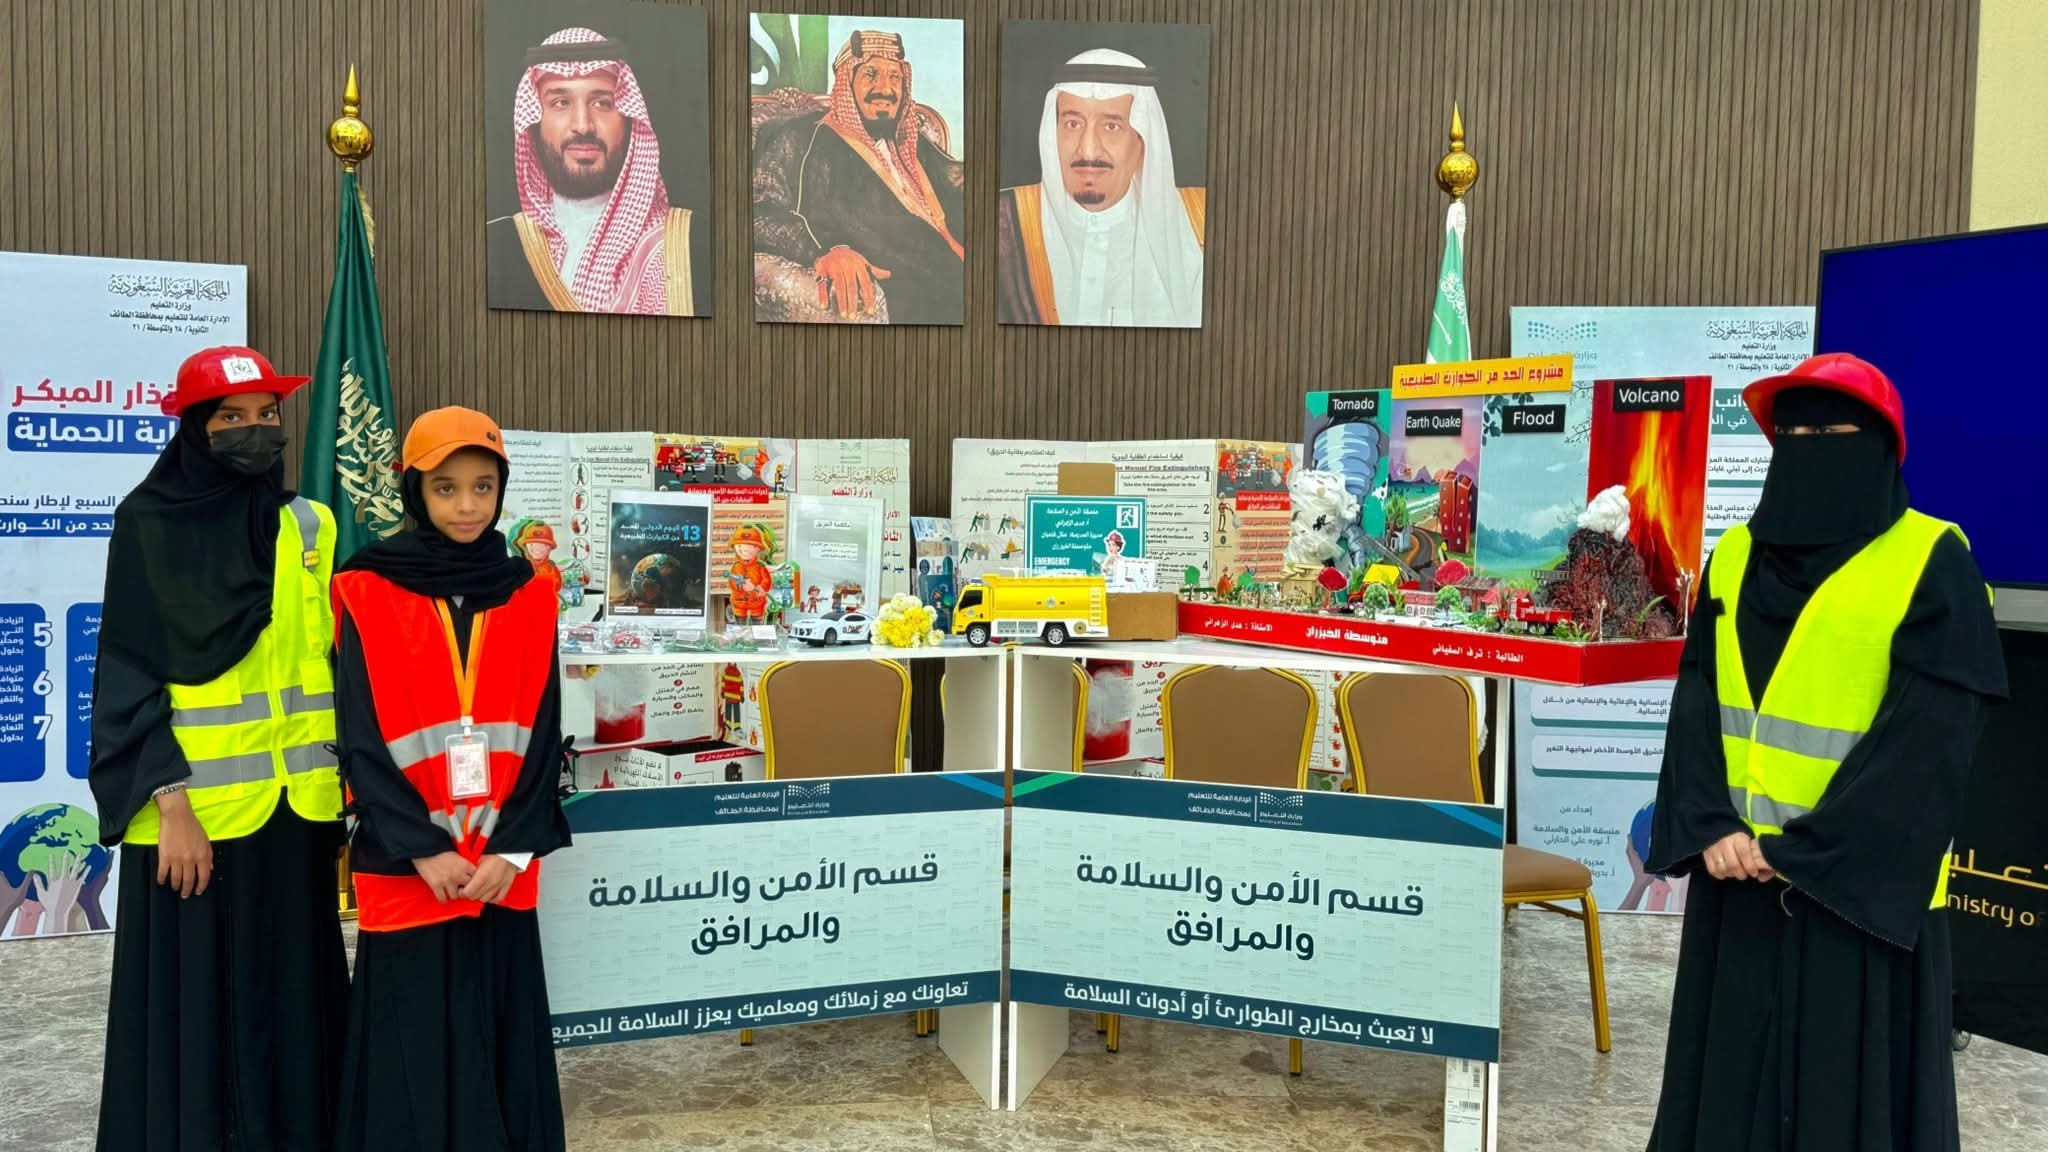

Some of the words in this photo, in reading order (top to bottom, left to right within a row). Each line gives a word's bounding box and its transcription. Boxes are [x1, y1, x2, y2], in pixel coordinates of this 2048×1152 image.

[1399, 372, 1439, 390] الطبيعية
[1443, 367, 1482, 387] الكوارث
[1503, 366, 1524, 382] الحد
[1528, 363, 1563, 383] مشروع
[12, 378, 112, 408] المبكر
[1332, 397, 1375, 411] Tornado
[1618, 387, 1680, 404] Volcano
[1406, 416, 1430, 429] Earth
[1432, 415, 1462, 430] Quake
[1512, 411, 1555, 426] Flood
[1727, 414, 1747, 430] في
[14, 416, 124, 448] الحماية
[75, 495, 116, 509] السبع
[1203, 504, 1210, 514] 2
[65, 521, 87, 532] من
[681, 525, 701, 542] 13
[1203, 531, 1209, 542] 3
[1034, 557, 1070, 566] EMERGENCY
[1203, 560, 1208, 571] 4
[33, 622, 52, 648] 5
[1344, 629, 1388, 646] متوسطة
[33, 671, 53, 696] 6
[33, 715, 53, 741] 7
[1559, 806, 1571, 814] من
[1571, 825, 1591, 834] الأمن
[759, 857, 846, 899] الأمن
[853, 852, 938, 893] قسم
[1076, 855, 1223, 902] والسلامة
[589, 870, 750, 908] والسلامة
[1232, 871, 1320, 906] الأمن
[1327, 884, 1425, 917] قسم
[691, 911, 840, 955] والمرافق
[1167, 910, 1315, 960] والمرافق
[824, 989, 879, 1013] زملائك
[883, 989, 907, 1009] مع
[912, 980, 968, 1002] تعاونك
[1064, 983, 1131, 1006] السلامة
[1136, 989, 1187, 1014] أدوات
[737, 997, 818, 1020] ومعلميك
[1192, 995, 1209, 1017] أو
[1215, 998, 1293, 1028] الطوارئ
[618, 1009, 688, 1033] السلامة
[695, 1007, 732, 1028] يعزز
[1299, 1014, 1362, 1039] بمخارج
[1368, 1020, 1415, 1042] تعبث
[1421, 1026, 1434, 1045] لا
